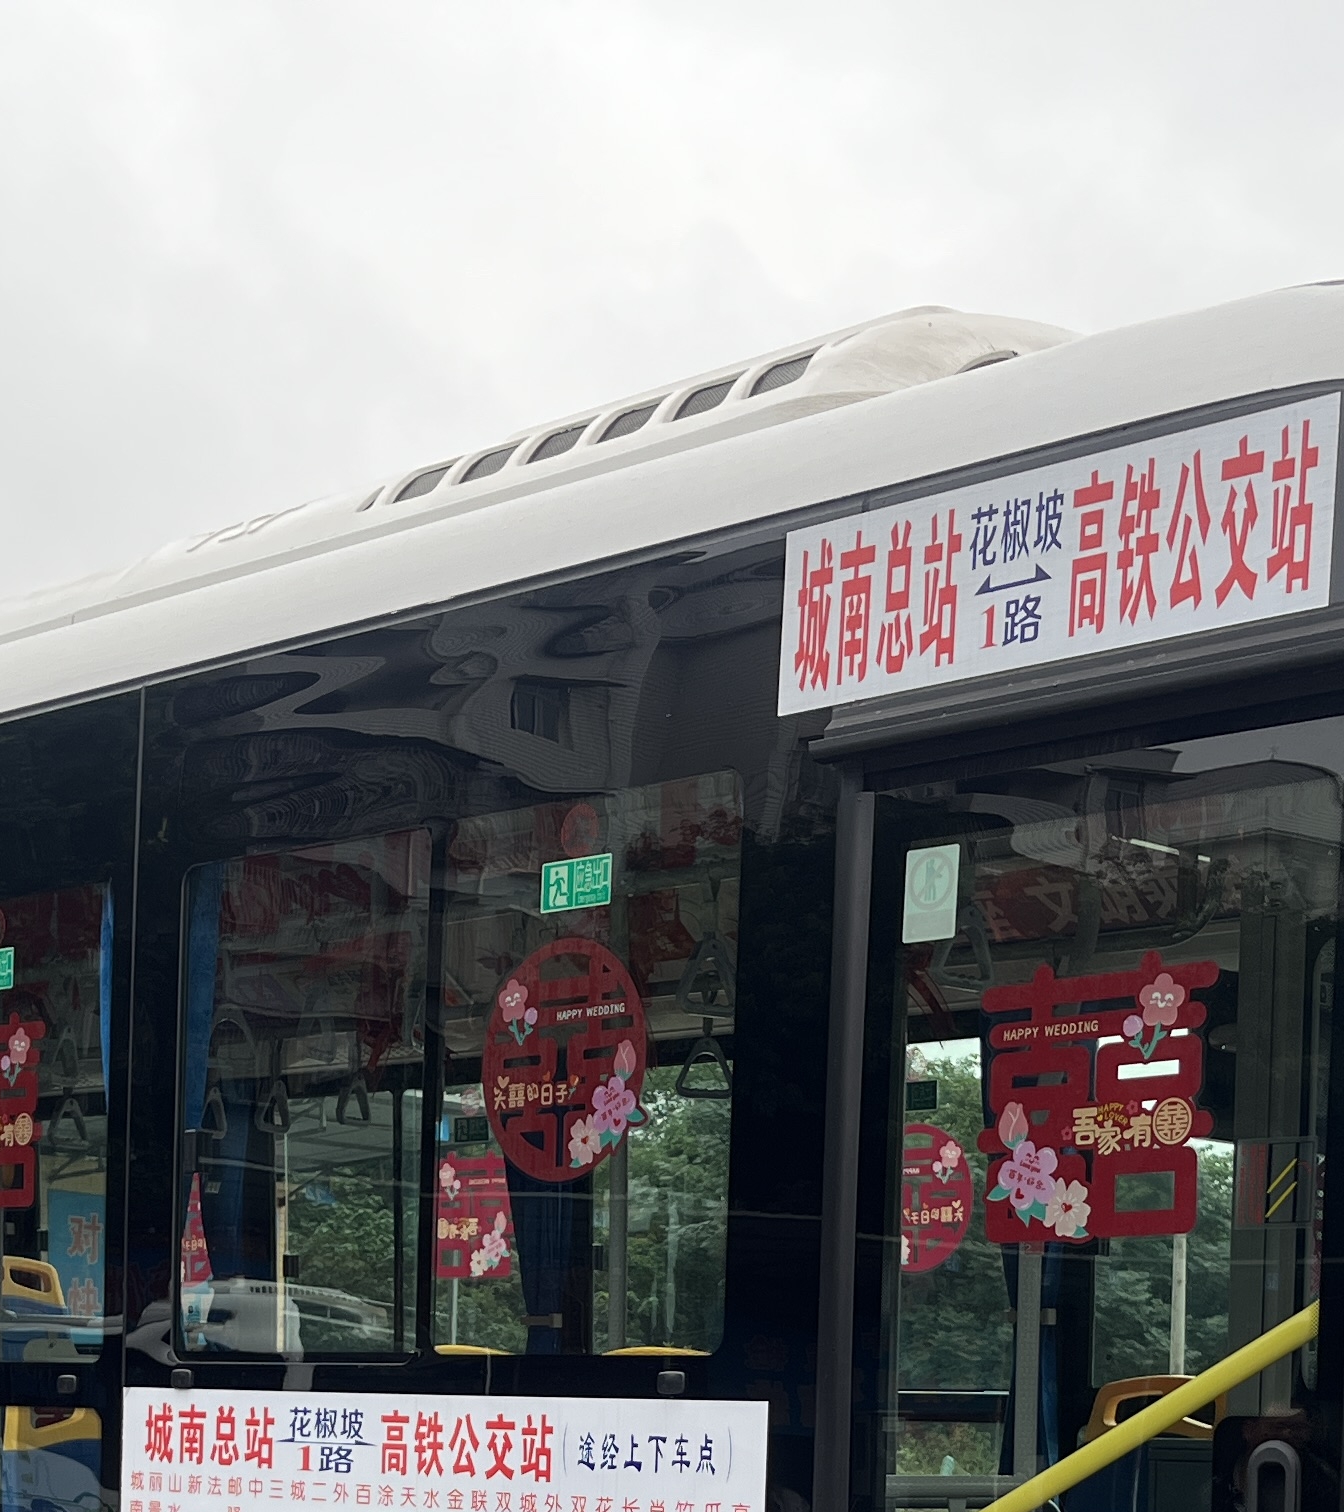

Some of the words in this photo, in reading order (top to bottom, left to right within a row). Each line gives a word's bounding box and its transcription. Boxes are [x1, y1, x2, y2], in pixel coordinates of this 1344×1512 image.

[794, 506, 962, 692] 城南总站
[969, 488, 1065, 571] 花椒坡
[1068, 418, 1319, 638] 高铁公交站
[978, 593, 1043, 649] 1路
[557, 1010, 583, 1021] HAPPY
[586, 1002, 625, 1017] WEDDING
[1003, 1026, 1039, 1041] HAPPY
[1044, 1020, 1099, 1037] WEDDING
[144, 1402, 274, 1467] 城南总站
[288, 1406, 365, 1441] 花椒坡
[380, 1410, 555, 1482] 高铁公交站
[297, 1447, 354, 1474] 1路
